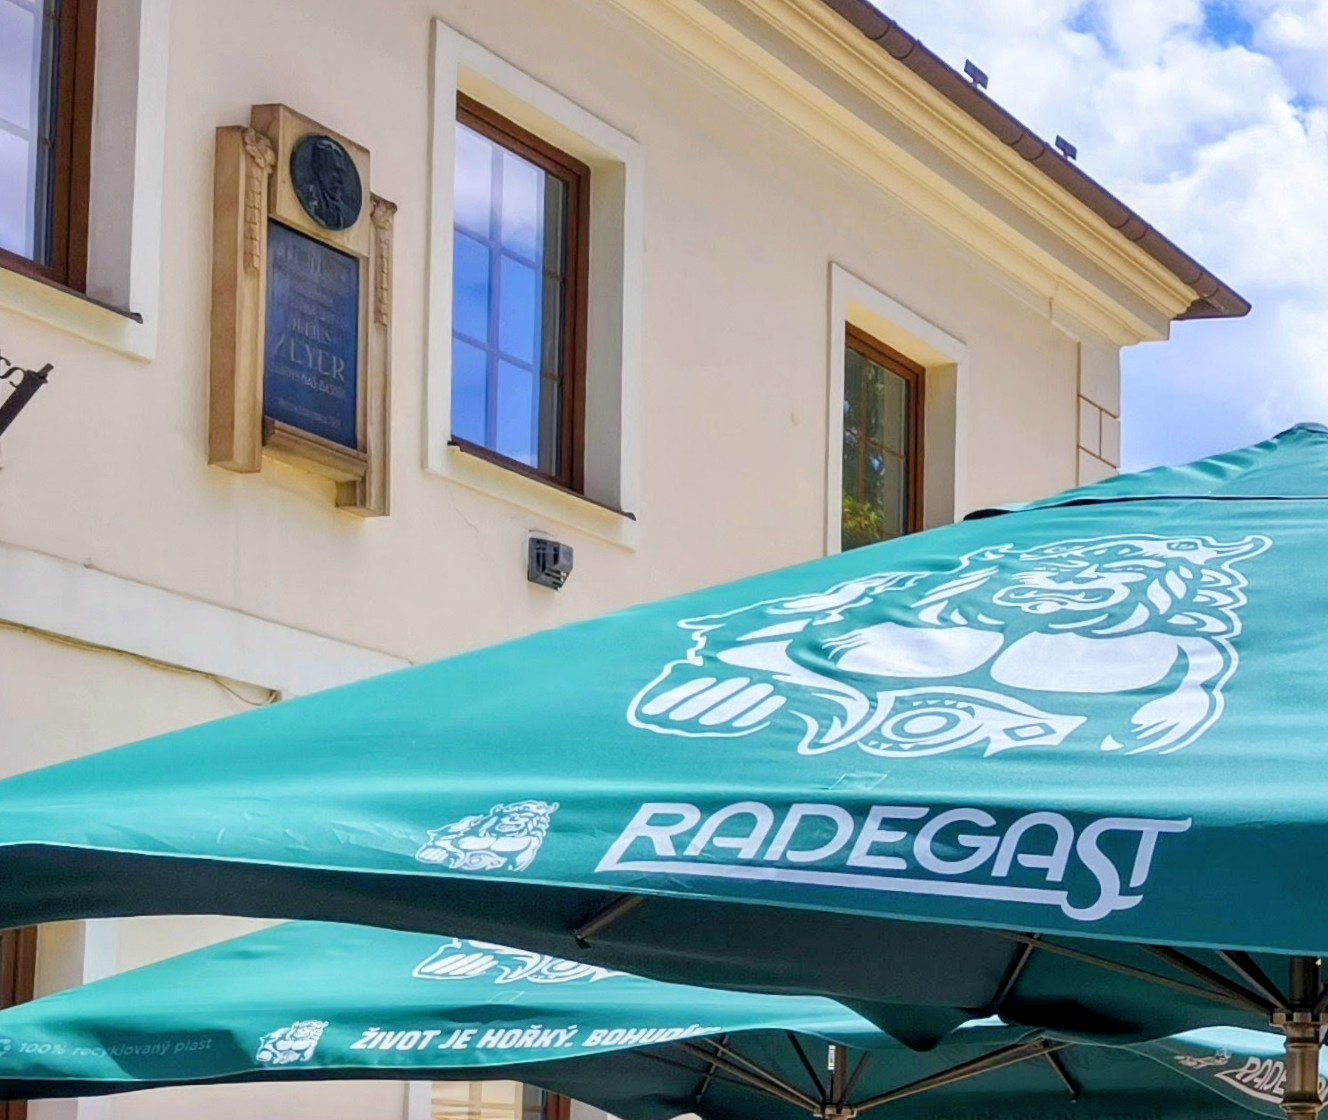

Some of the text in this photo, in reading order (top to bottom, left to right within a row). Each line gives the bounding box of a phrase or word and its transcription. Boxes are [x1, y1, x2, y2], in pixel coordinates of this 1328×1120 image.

[594, 801, 1193, 921] RADEGAST
[19, 1038, 212, 1058] 100% recyklovaný plast
[351, 1023, 722, 1050] ŽIVOT JE HOŘKÝ. BOHUDÍ
